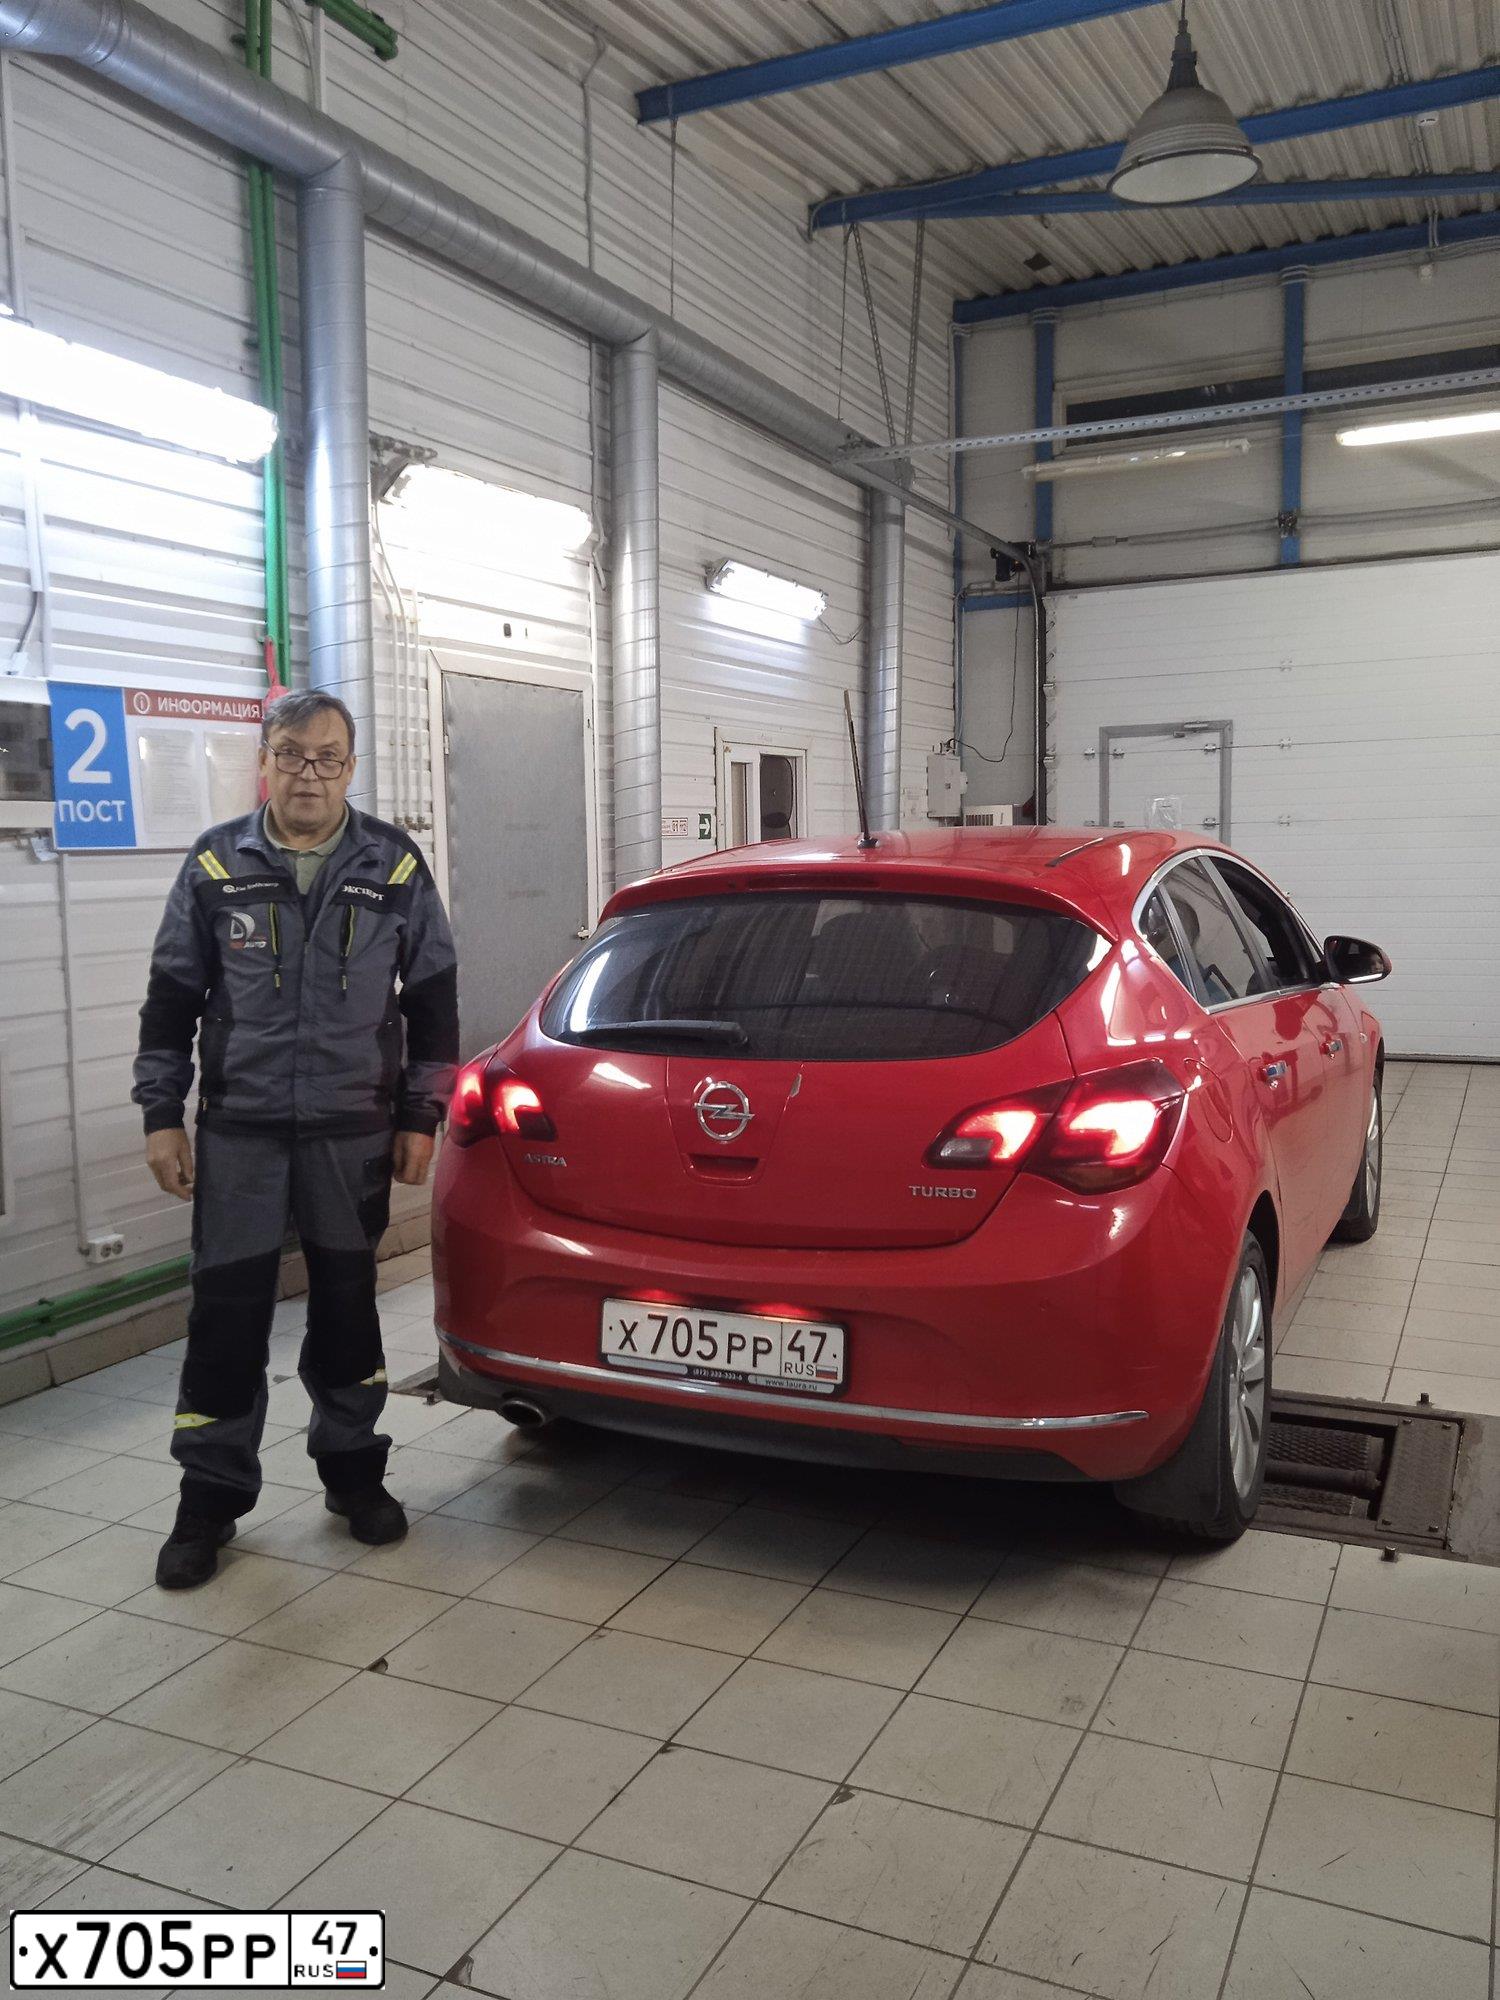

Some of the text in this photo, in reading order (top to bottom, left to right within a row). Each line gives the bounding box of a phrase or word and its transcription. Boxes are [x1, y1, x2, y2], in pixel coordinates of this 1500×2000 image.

[157, 696, 261, 720] ИНФОРМАЦИЯ
[64, 707, 112, 785] 2
[57, 799, 127, 823] ПОСТ
[523, 1152, 568, 1167] ASTRA
[908, 1185, 977, 1199] TURBO
[787, 1328, 828, 1364] 47
[783, 1361, 815, 1377] RUS
[765, 1379, 818, 1391] www.laura.ru
